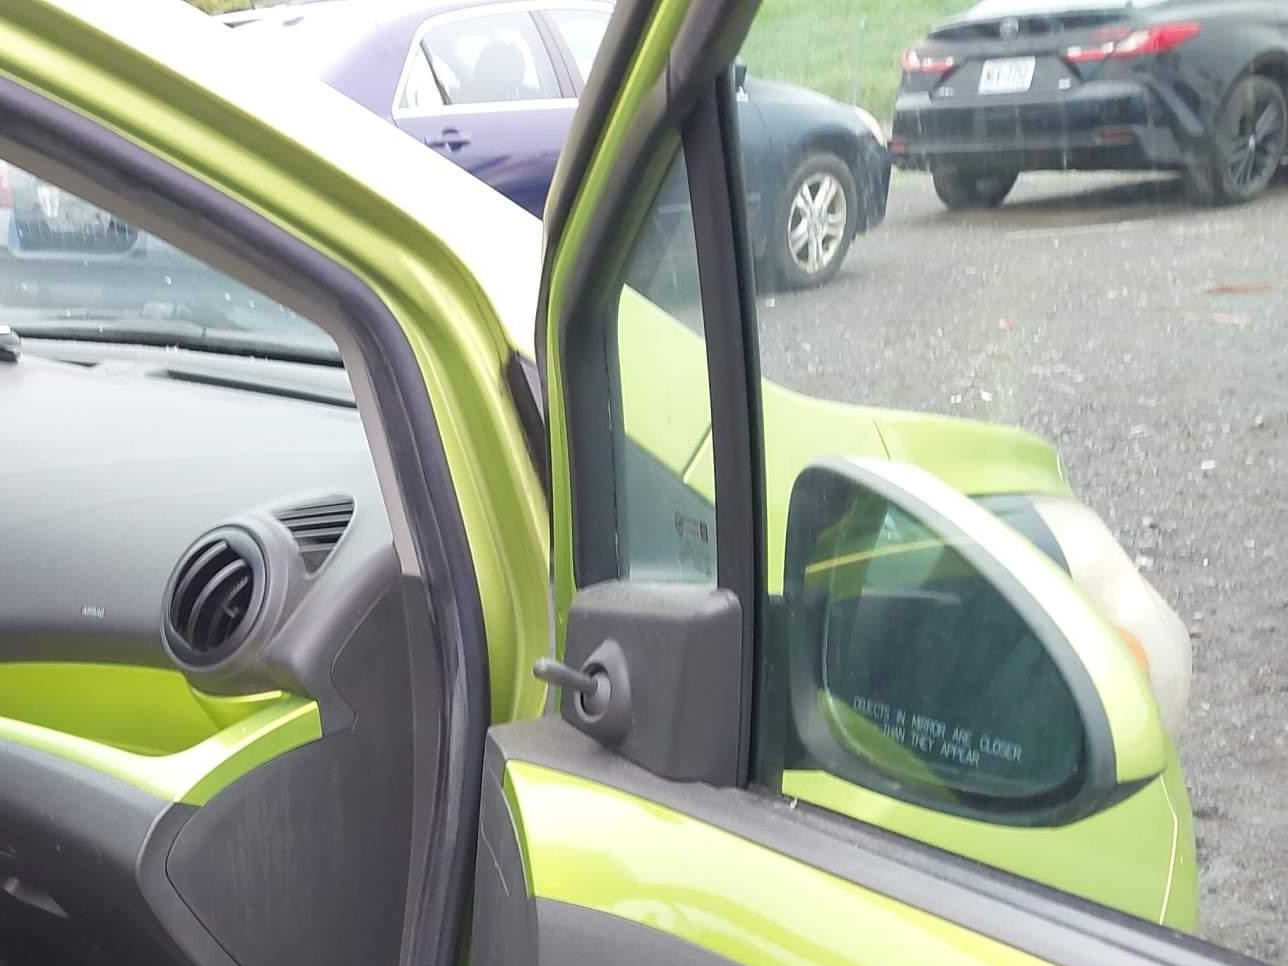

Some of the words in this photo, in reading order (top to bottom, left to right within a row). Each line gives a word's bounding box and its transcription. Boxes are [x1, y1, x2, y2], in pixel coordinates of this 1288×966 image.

[883, 724, 906, 744] THAN
[912, 733, 935, 752] THEY
[941, 743, 980, 767] APPEAR
[896, 709, 906, 726] IN
[912, 714, 946, 739] MIRROR
[952, 727, 973, 745] ARE
[980, 734, 1023, 762] CLOSER
